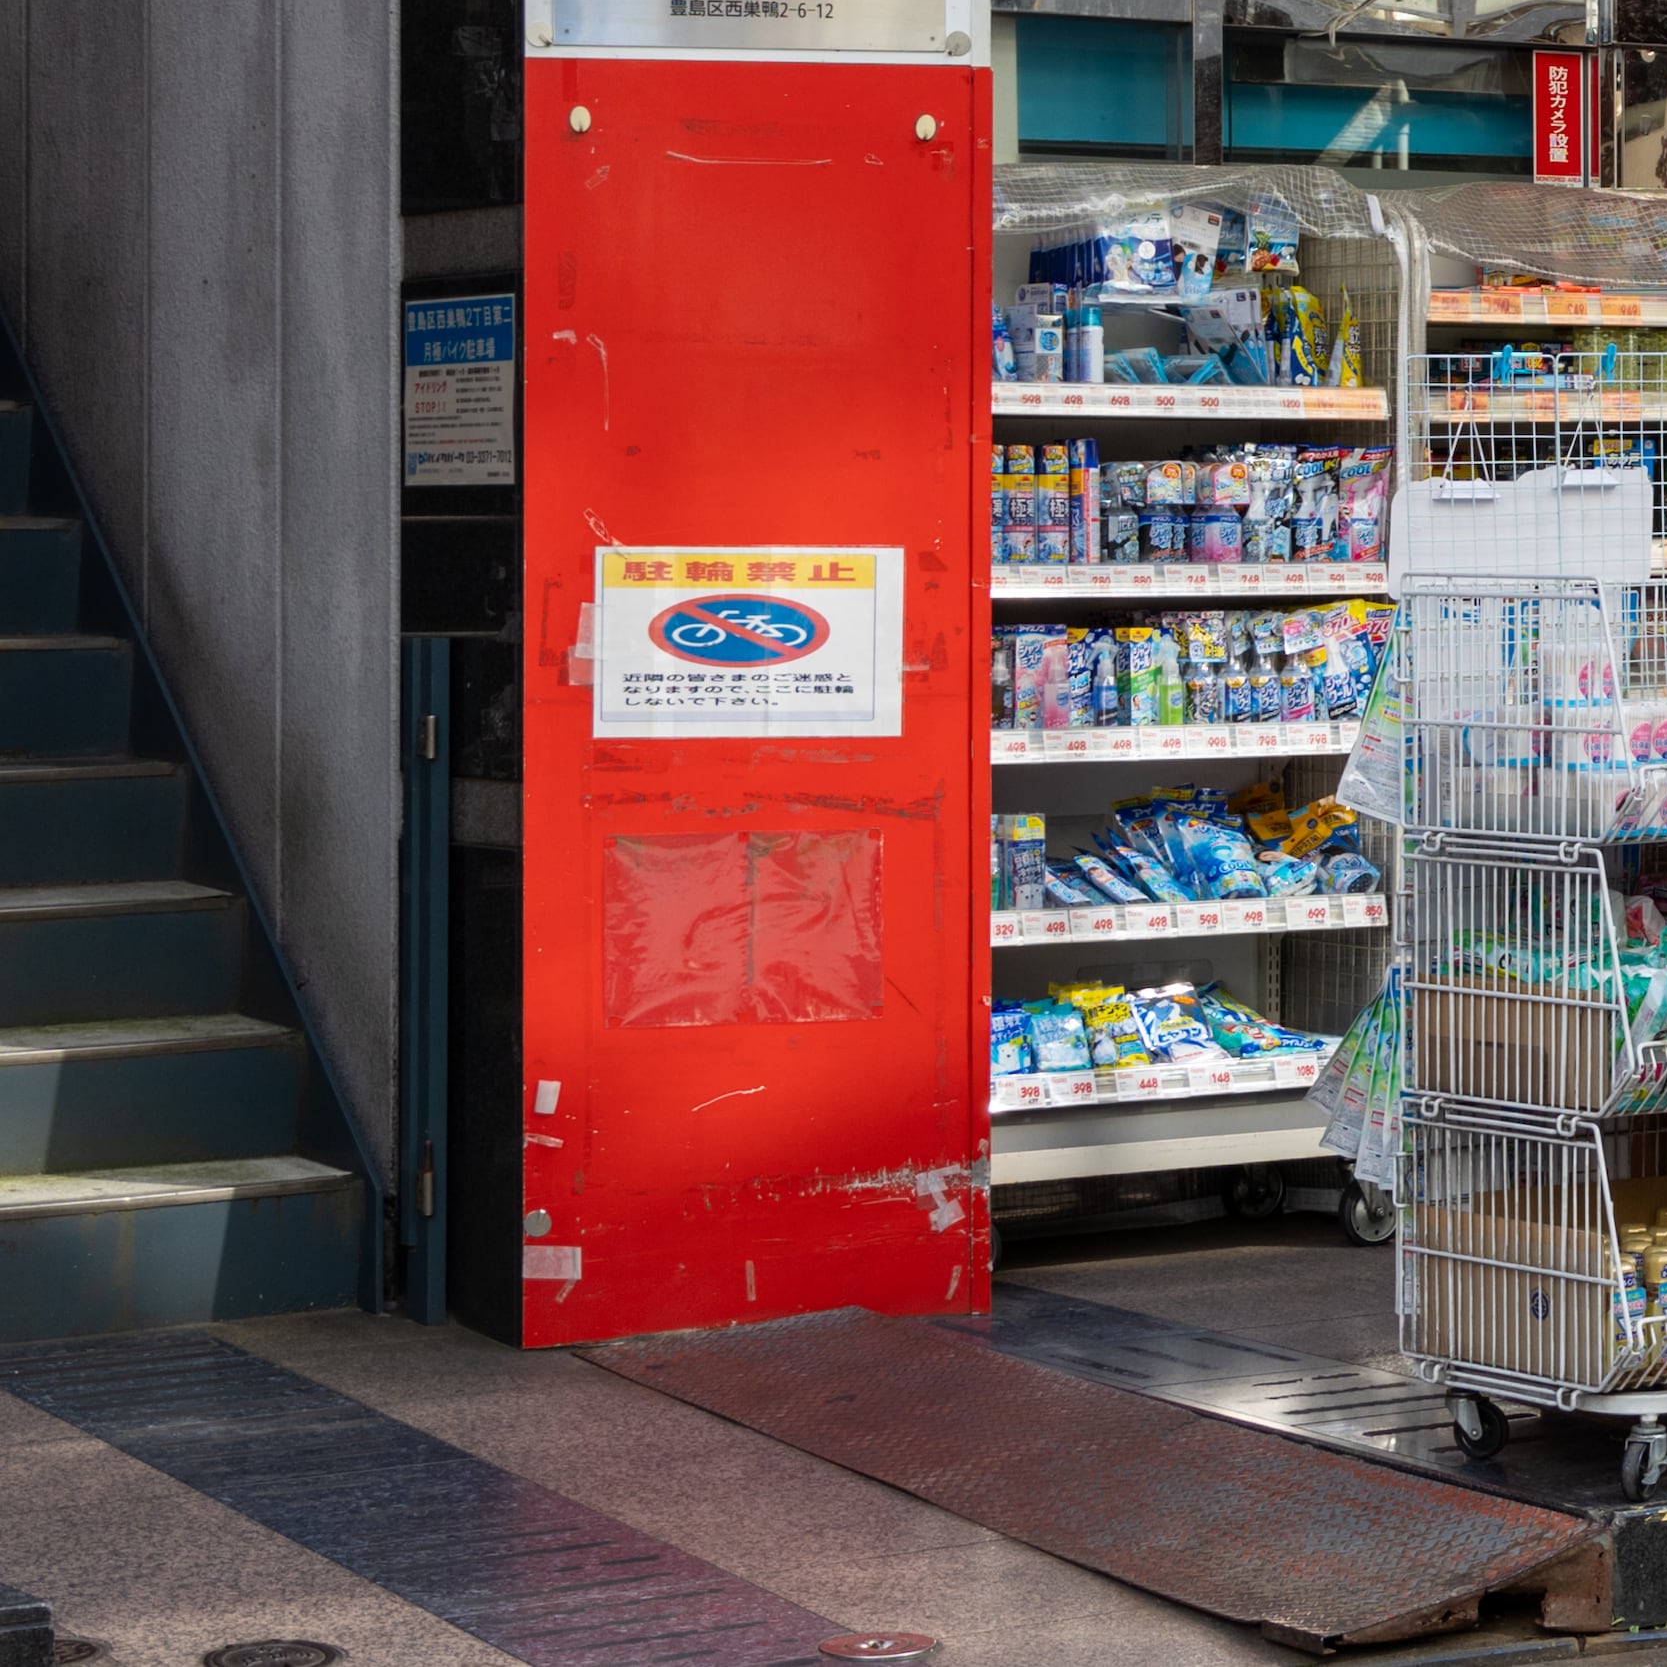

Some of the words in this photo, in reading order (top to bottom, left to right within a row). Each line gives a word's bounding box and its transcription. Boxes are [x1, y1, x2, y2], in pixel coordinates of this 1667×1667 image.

[1547, 65, 1570, 164] 防犯カメラ設置
[622, 560, 857, 583] 駐輪禁止
[622, 672, 853, 684] 近隣の皆さまのご迷惑と
[622, 684, 855, 696] なりますので、ここに駐輪
[624, 696, 779, 708] しないで下さい。
